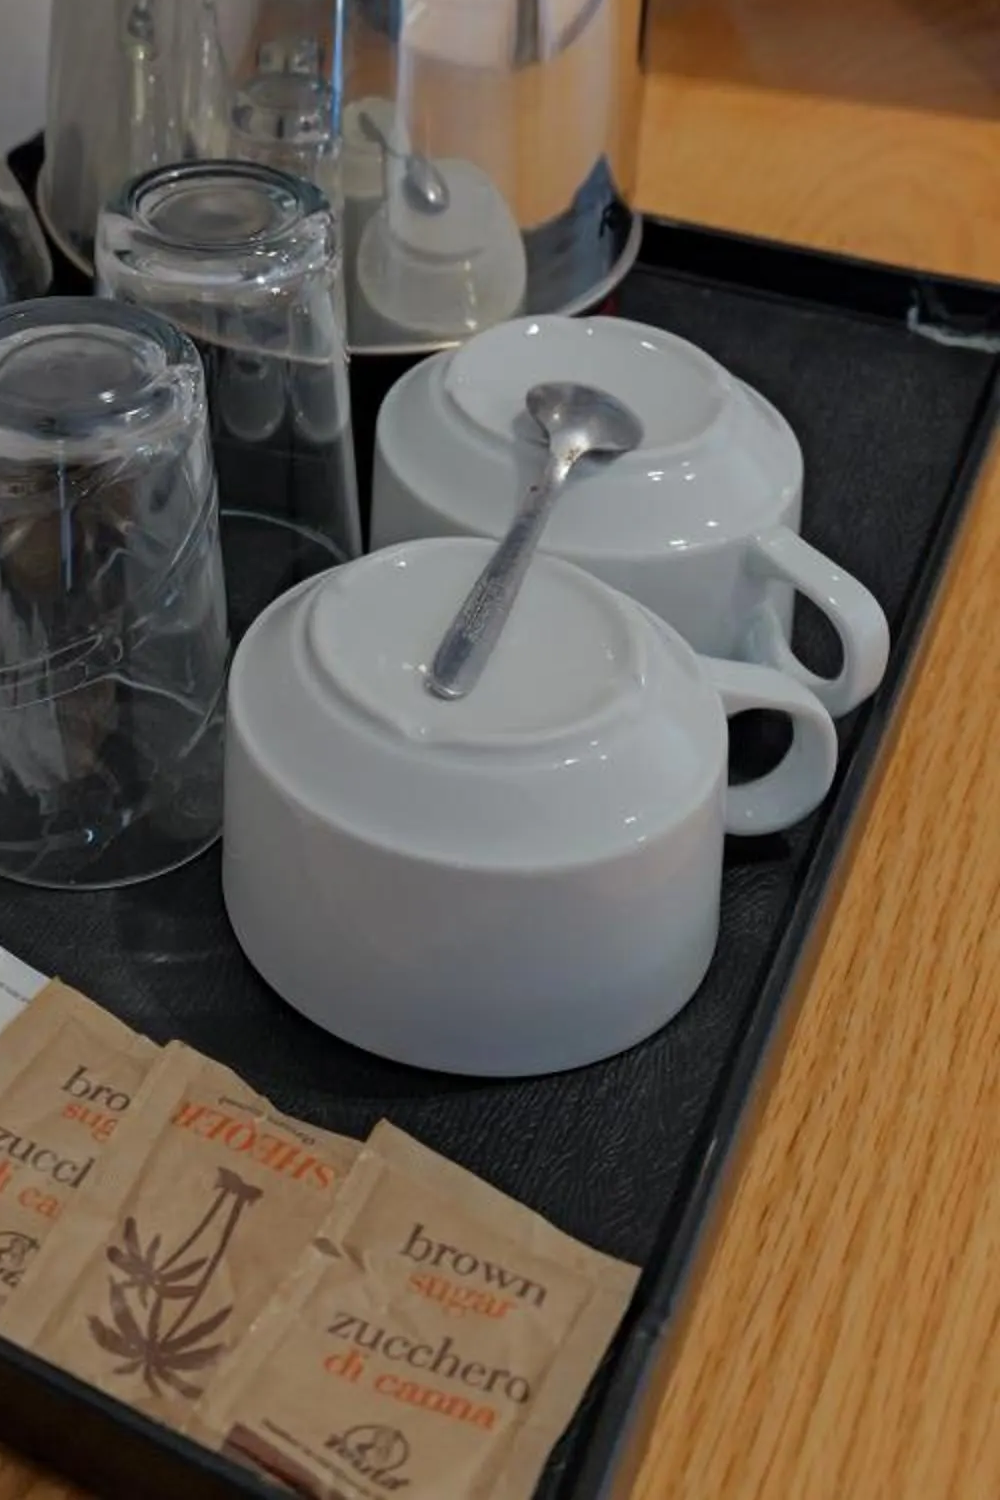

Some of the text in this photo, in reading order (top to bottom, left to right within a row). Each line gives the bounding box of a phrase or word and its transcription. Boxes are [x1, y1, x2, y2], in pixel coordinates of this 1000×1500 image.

[60, 1064, 132, 1113] bro
[62, 1102, 119, 1144] sug
[400, 1222, 548, 1309] brown
[408, 1270, 517, 1319] sugar
[323, 1349, 497, 1431] di canna
[327, 1311, 531, 1404] zucchero
